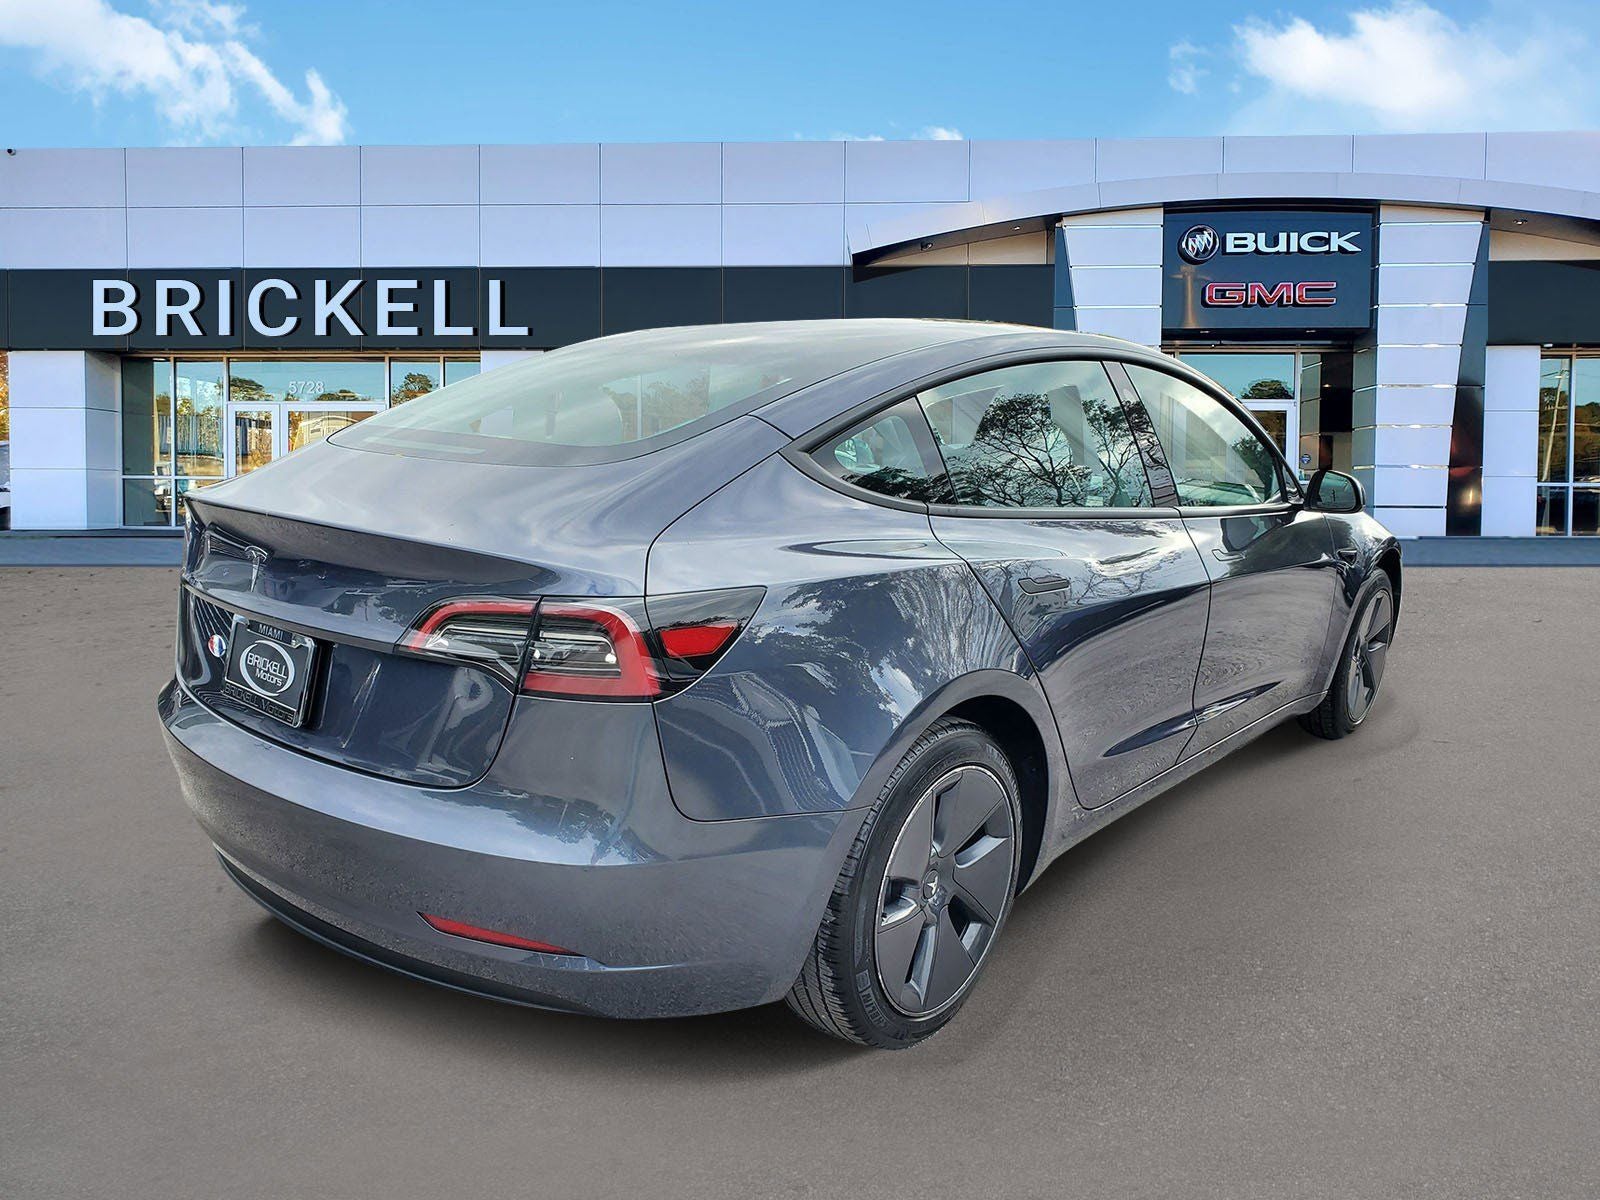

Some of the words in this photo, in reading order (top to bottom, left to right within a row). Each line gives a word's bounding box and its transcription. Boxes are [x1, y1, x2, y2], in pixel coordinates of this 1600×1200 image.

[1226, 231, 1361, 253] BUICK
[1205, 282, 1337, 305] GMC
[92, 278, 529, 337] BRICKELL
[288, 380, 325, 394] 5728
[259, 624, 283, 640] MIAMI
[255, 668, 282, 687] Motors
[261, 700, 294, 722] Motors
